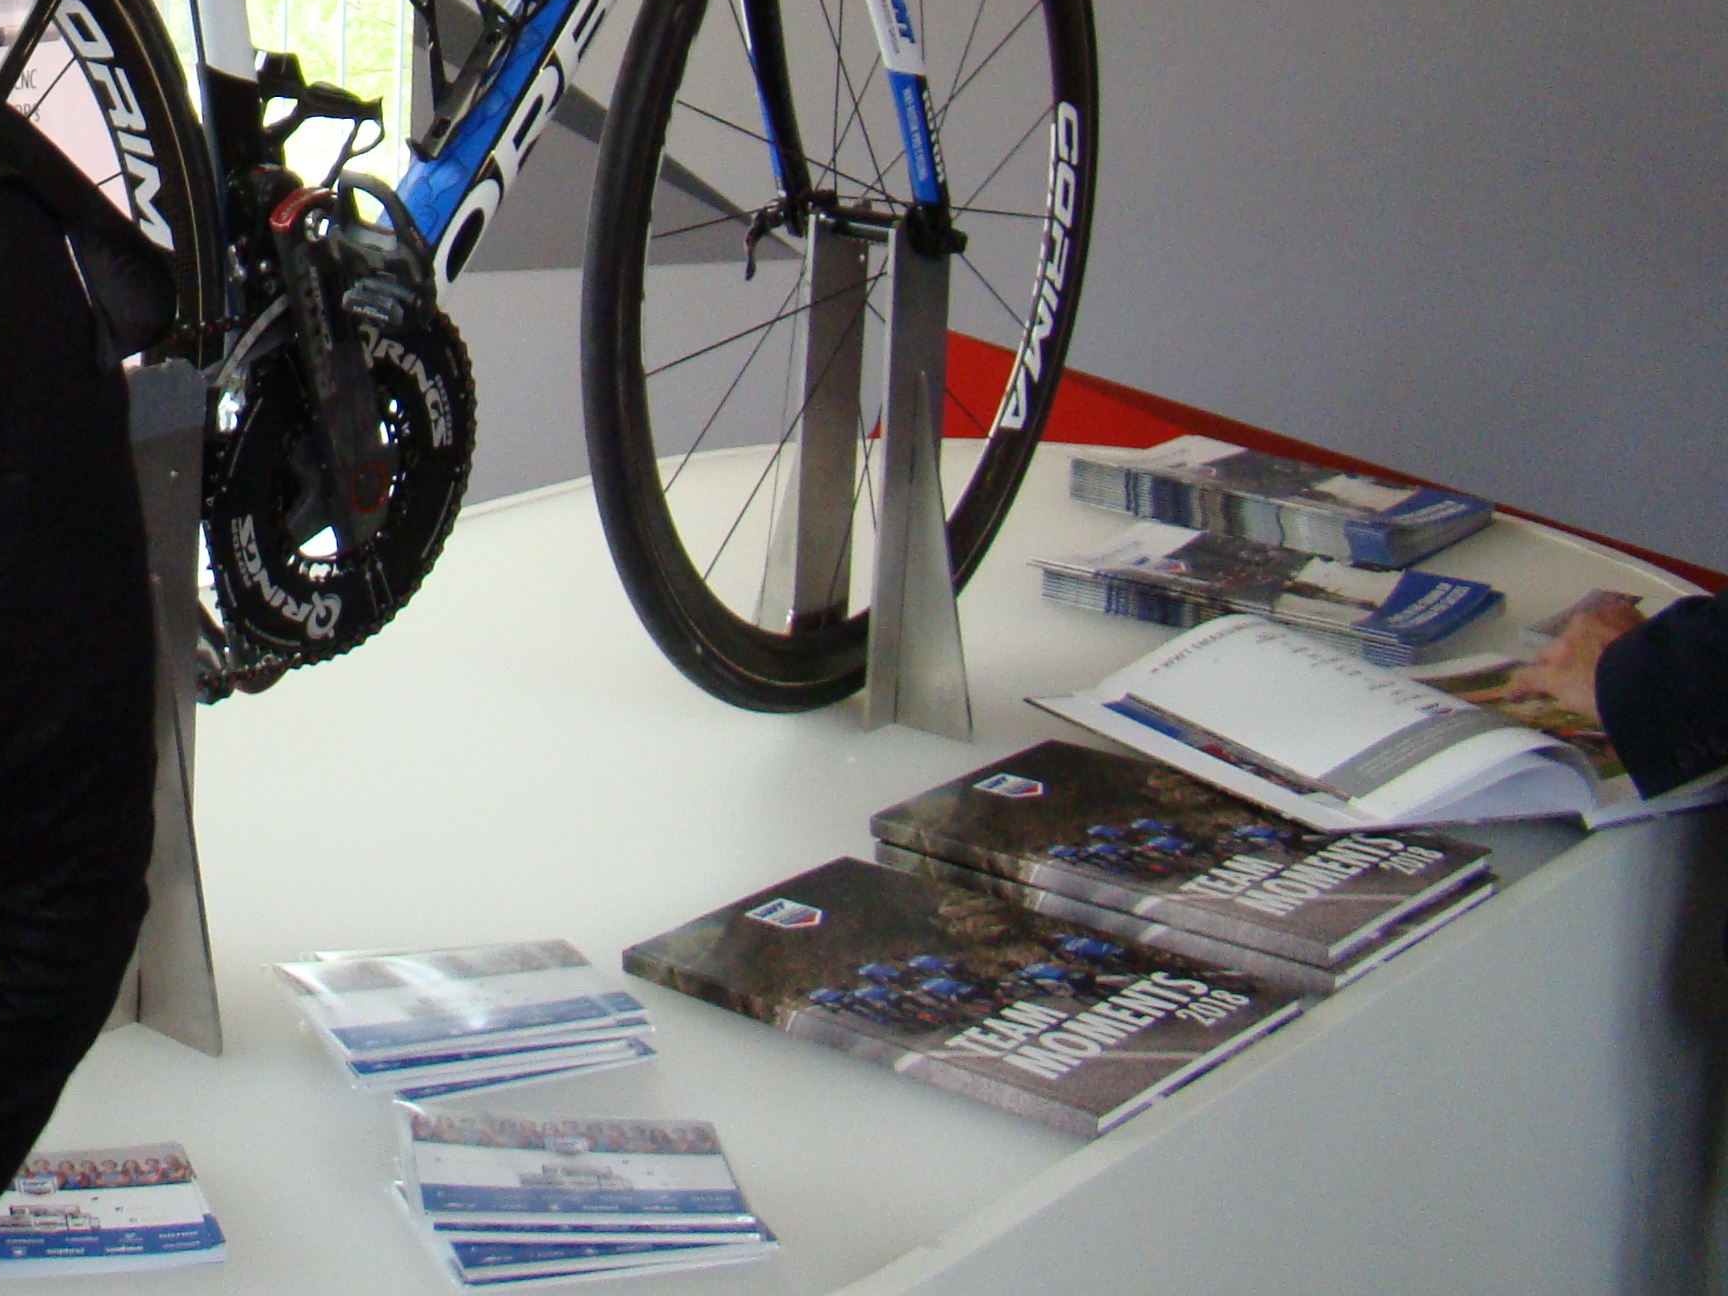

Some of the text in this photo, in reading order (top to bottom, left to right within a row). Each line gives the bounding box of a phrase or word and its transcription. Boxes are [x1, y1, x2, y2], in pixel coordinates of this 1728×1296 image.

[1179, 854, 1284, 899] TEAM
[1234, 832, 1404, 917] MOMENTS
[1378, 845, 1445, 876] 2018
[944, 1000, 1070, 1058] TEAM
[1002, 971, 1209, 1081] MOMENTS
[1175, 989, 1250, 1027] 2018
